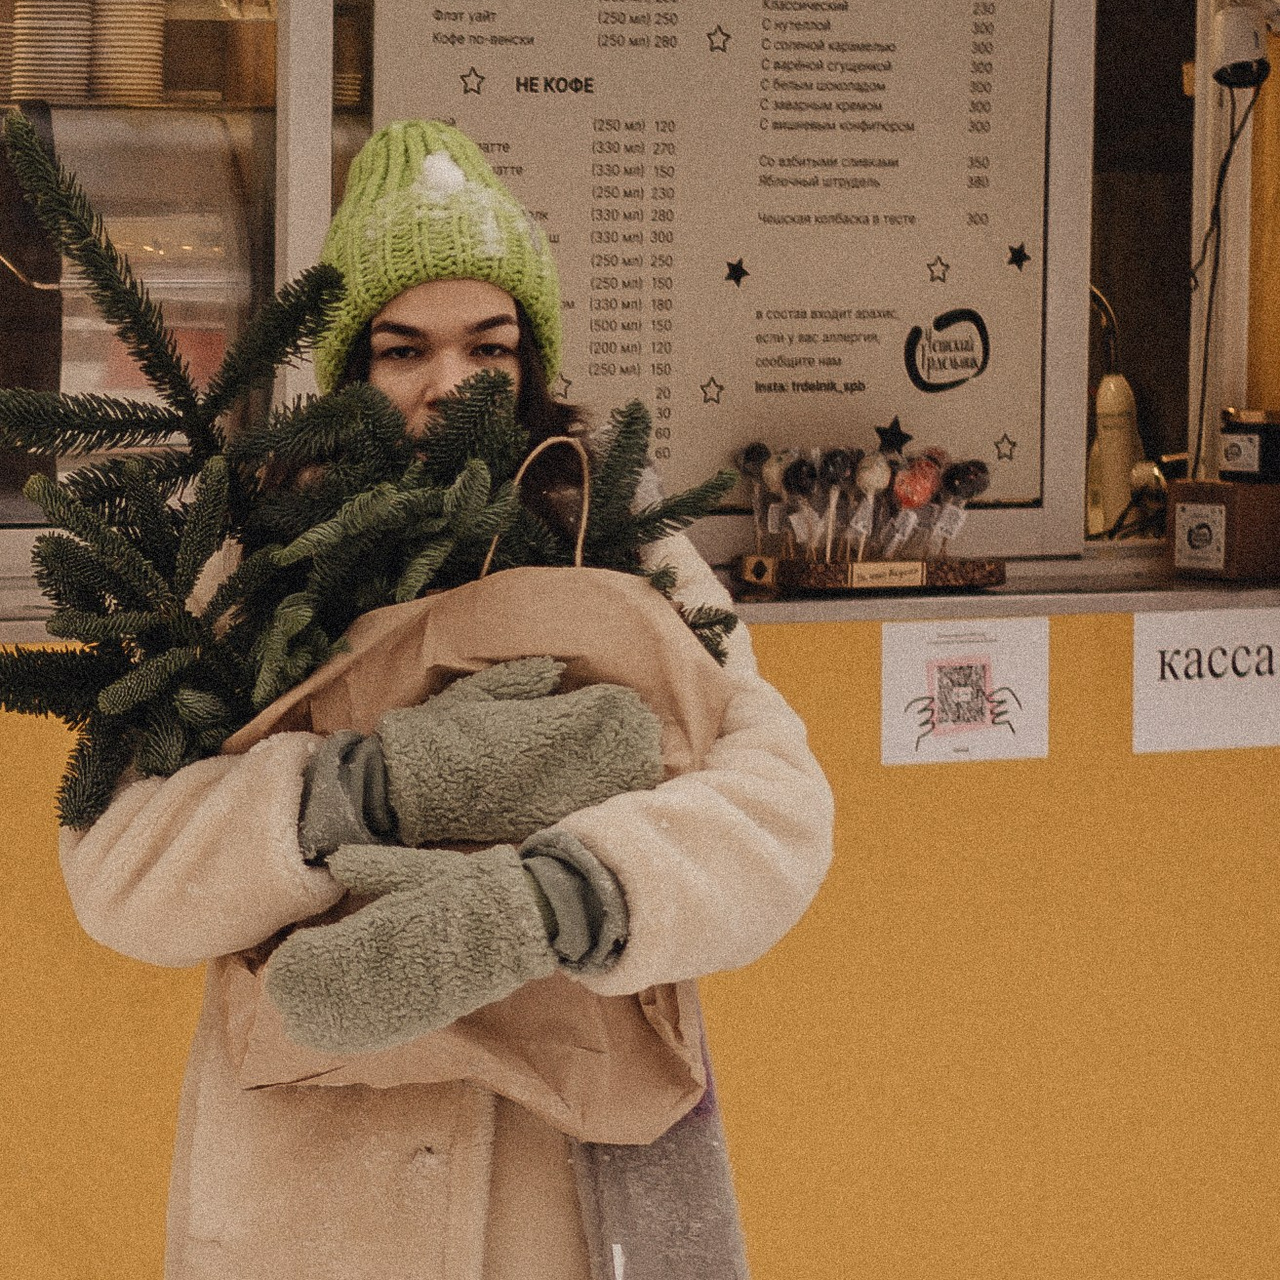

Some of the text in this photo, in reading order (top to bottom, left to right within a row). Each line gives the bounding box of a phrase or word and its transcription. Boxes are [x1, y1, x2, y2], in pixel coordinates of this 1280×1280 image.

[762, 0, 849, 13] Классический
[597, 11, 626, 27] (250
[654, 12, 678, 27] 250
[762, 18, 772, 32] С
[432, 31, 465, 47] Кофе
[596, 33, 626, 49] (250
[654, 35, 678, 50] 280
[761, 38, 771, 51] С
[761, 58, 771, 72] С
[516, 76, 595, 94] НЕ КОФЕ
[760, 78, 770, 91] С
[760, 98, 769, 111] С
[592, 118, 621, 133] (250
[655, 120, 676, 134] 120
[759, 118, 769, 131] С
[477, 141, 510, 154] атте
[591, 140, 621, 155] (330
[652, 142, 676, 156] 270
[759, 155, 776, 168] Со
[492, 164, 523, 177] атте
[591, 163, 621, 177] (330
[654, 165, 676, 179] 150
[591, 185, 620, 201] (250
[651, 186, 675, 201] 230
[590, 207, 620, 223] (330
[650, 208, 675, 223] 280
[590, 230, 619, 245] (330
[650, 230, 674, 245] 300
[590, 253, 619, 268] (250
[650, 253, 674, 268] 250
[590, 276, 618, 291] (250
[652, 276, 673, 291] 150
[589, 297, 618, 312] (330
[651, 298, 673, 312] 180
[766, 309, 807, 320] состав
[810, 309, 853, 321] входит
[589, 318, 617, 334] (500
[651, 319, 672, 333] 150
[589, 341, 617, 356] (200
[651, 341, 672, 356] 120
[588, 363, 616, 378] (250
[650, 363, 671, 377] 150
[1157, 643, 1275, 682] касса
